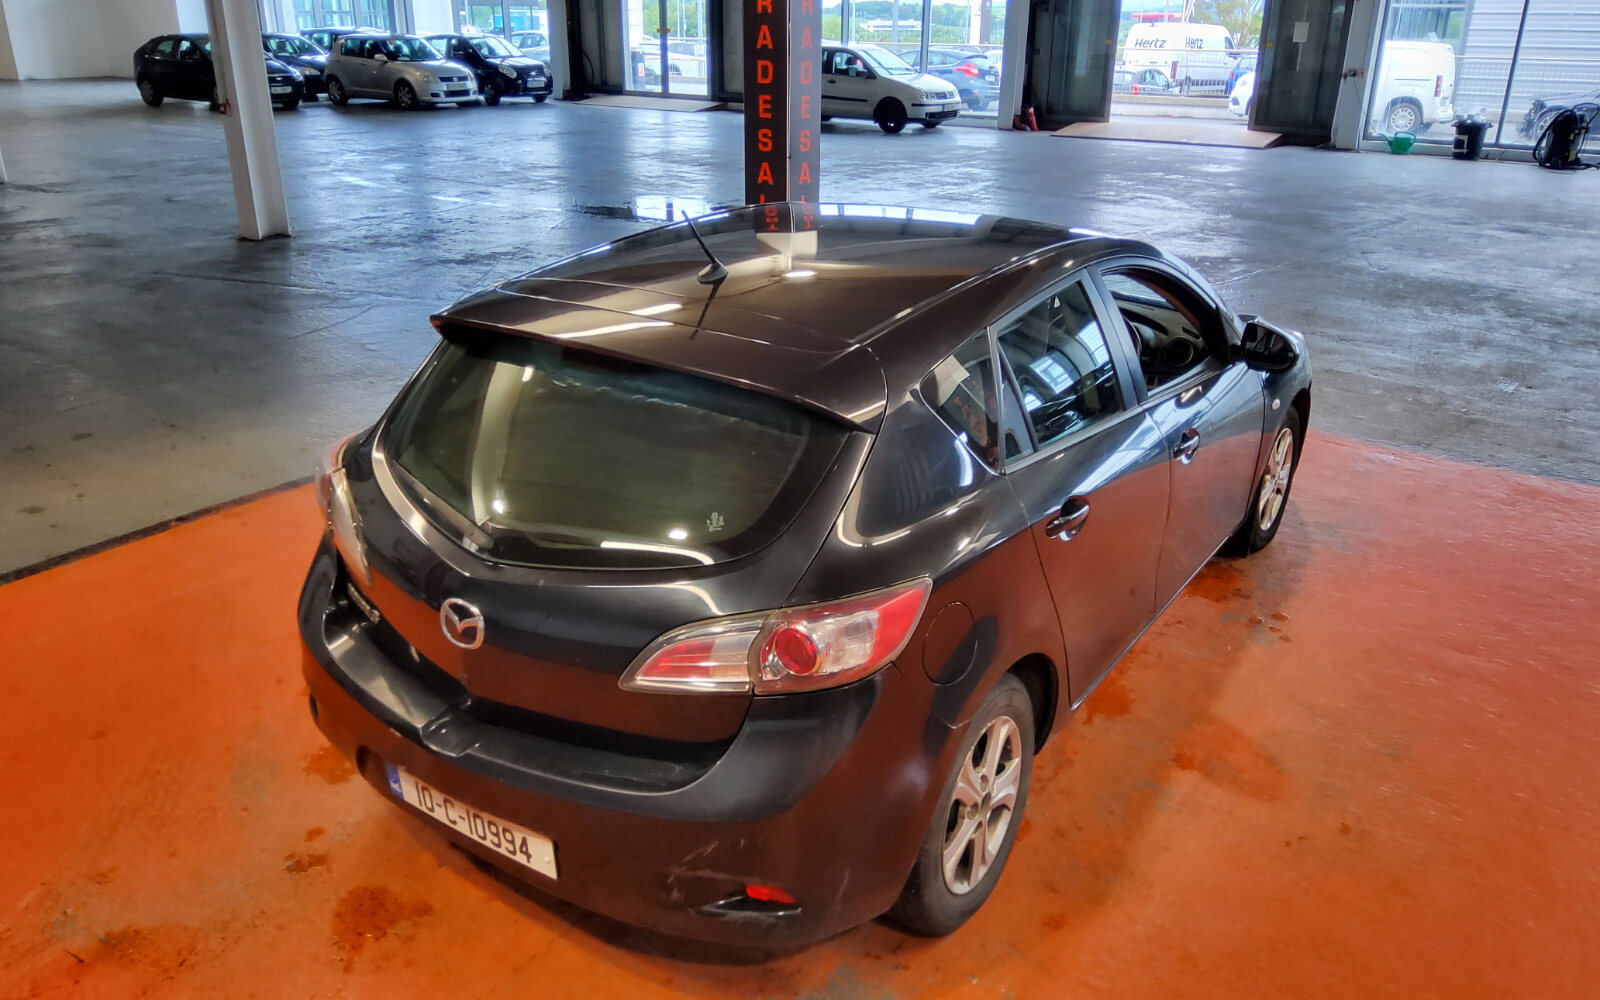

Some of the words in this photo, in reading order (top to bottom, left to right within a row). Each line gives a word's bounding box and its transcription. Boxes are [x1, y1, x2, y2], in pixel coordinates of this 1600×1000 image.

[1134, 37, 1167, 48] Hertz
[1184, 36, 1204, 49] Hertz
[414, 780, 533, 864] 10-C-10994
